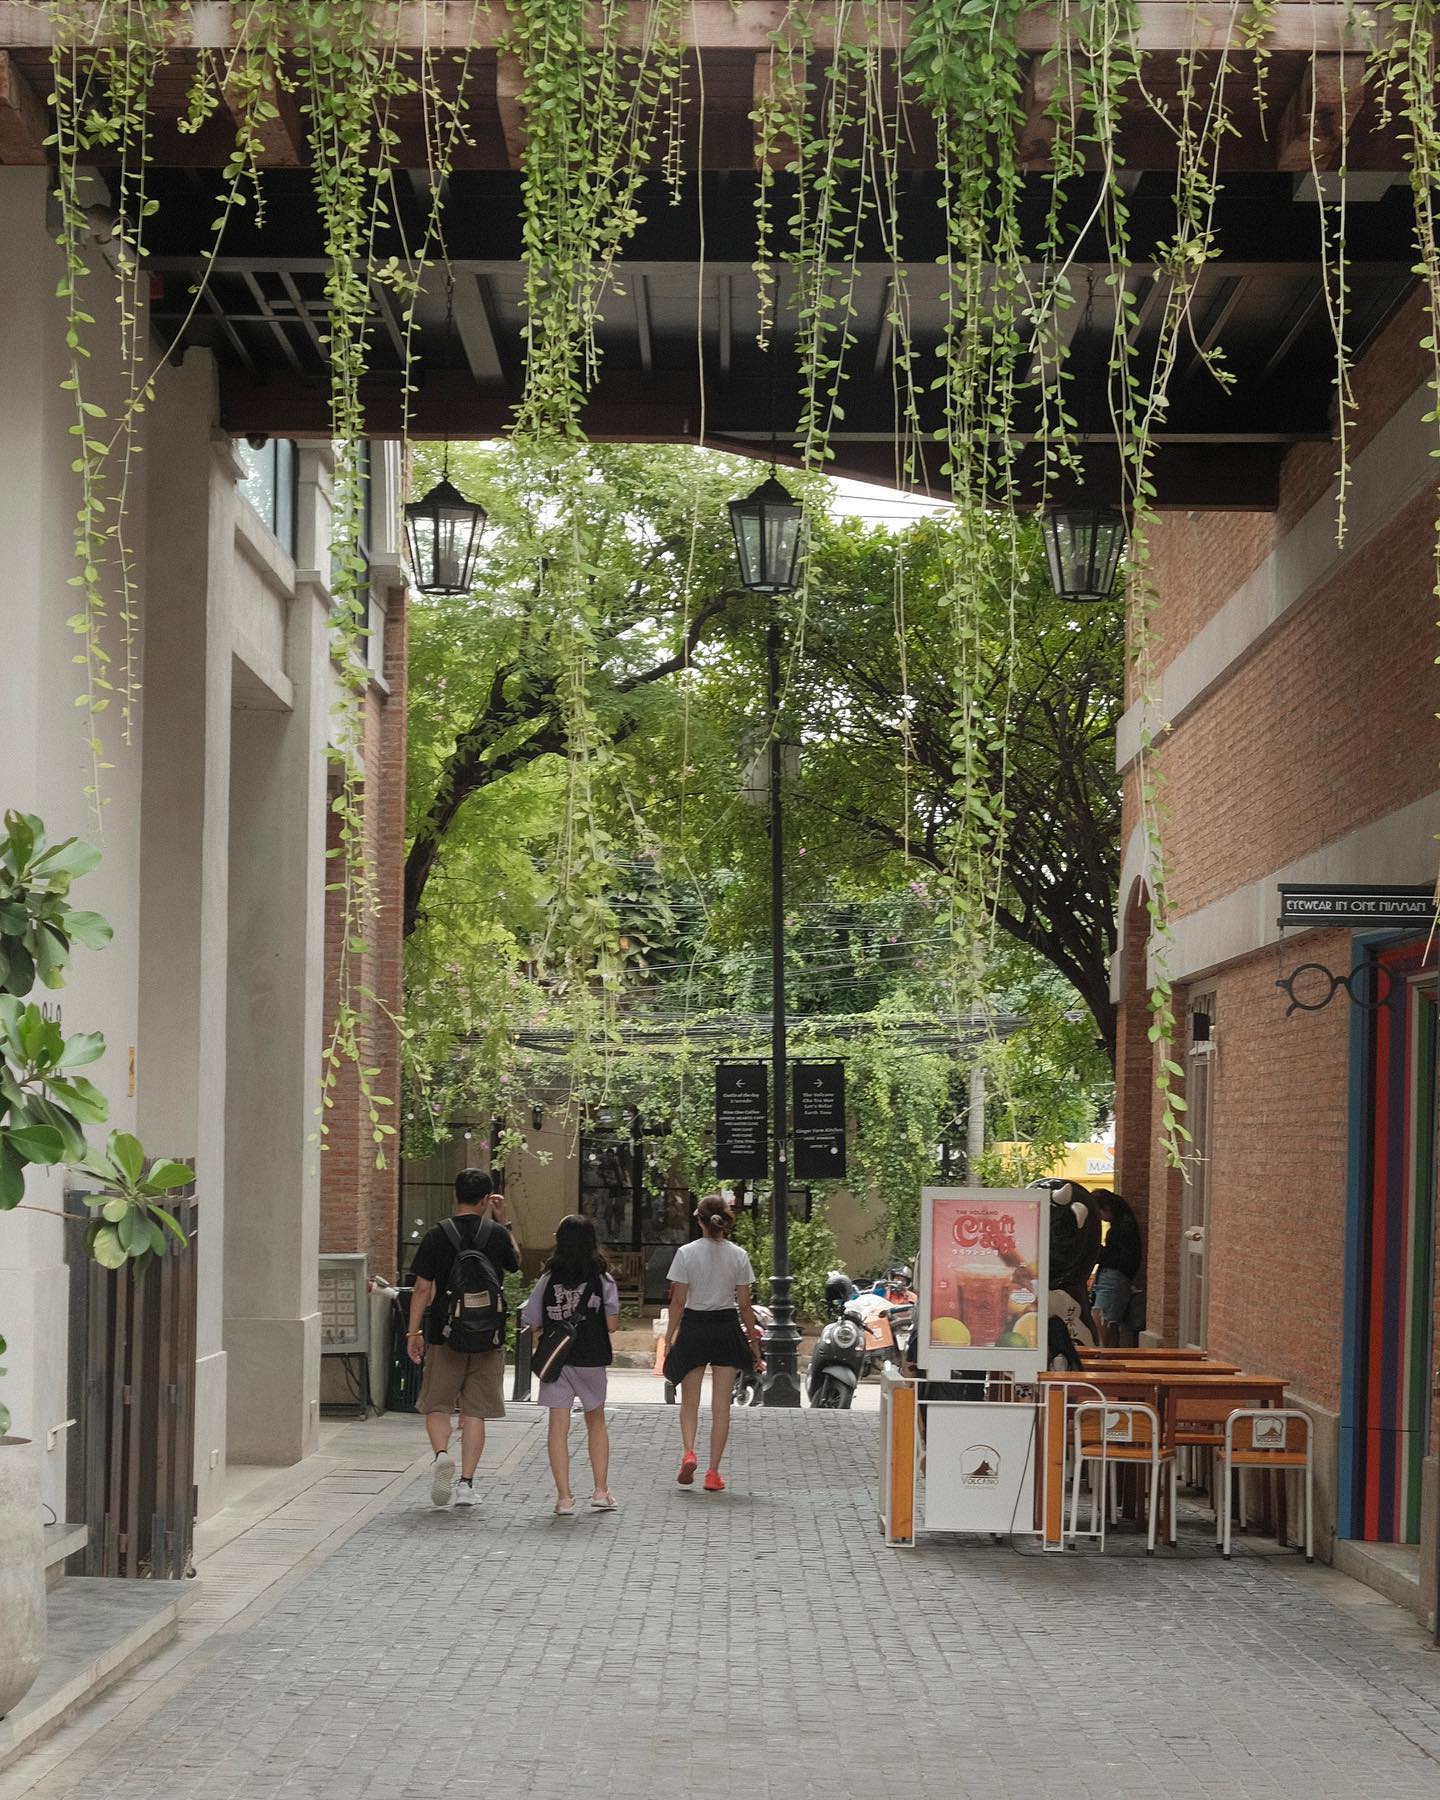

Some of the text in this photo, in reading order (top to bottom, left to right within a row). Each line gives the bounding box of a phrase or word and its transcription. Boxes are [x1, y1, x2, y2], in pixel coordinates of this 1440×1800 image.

[1286, 900, 1426, 912] EYEWEAR IN ONE NIMMAN
[961, 1477, 999, 1485] VOLCANO
